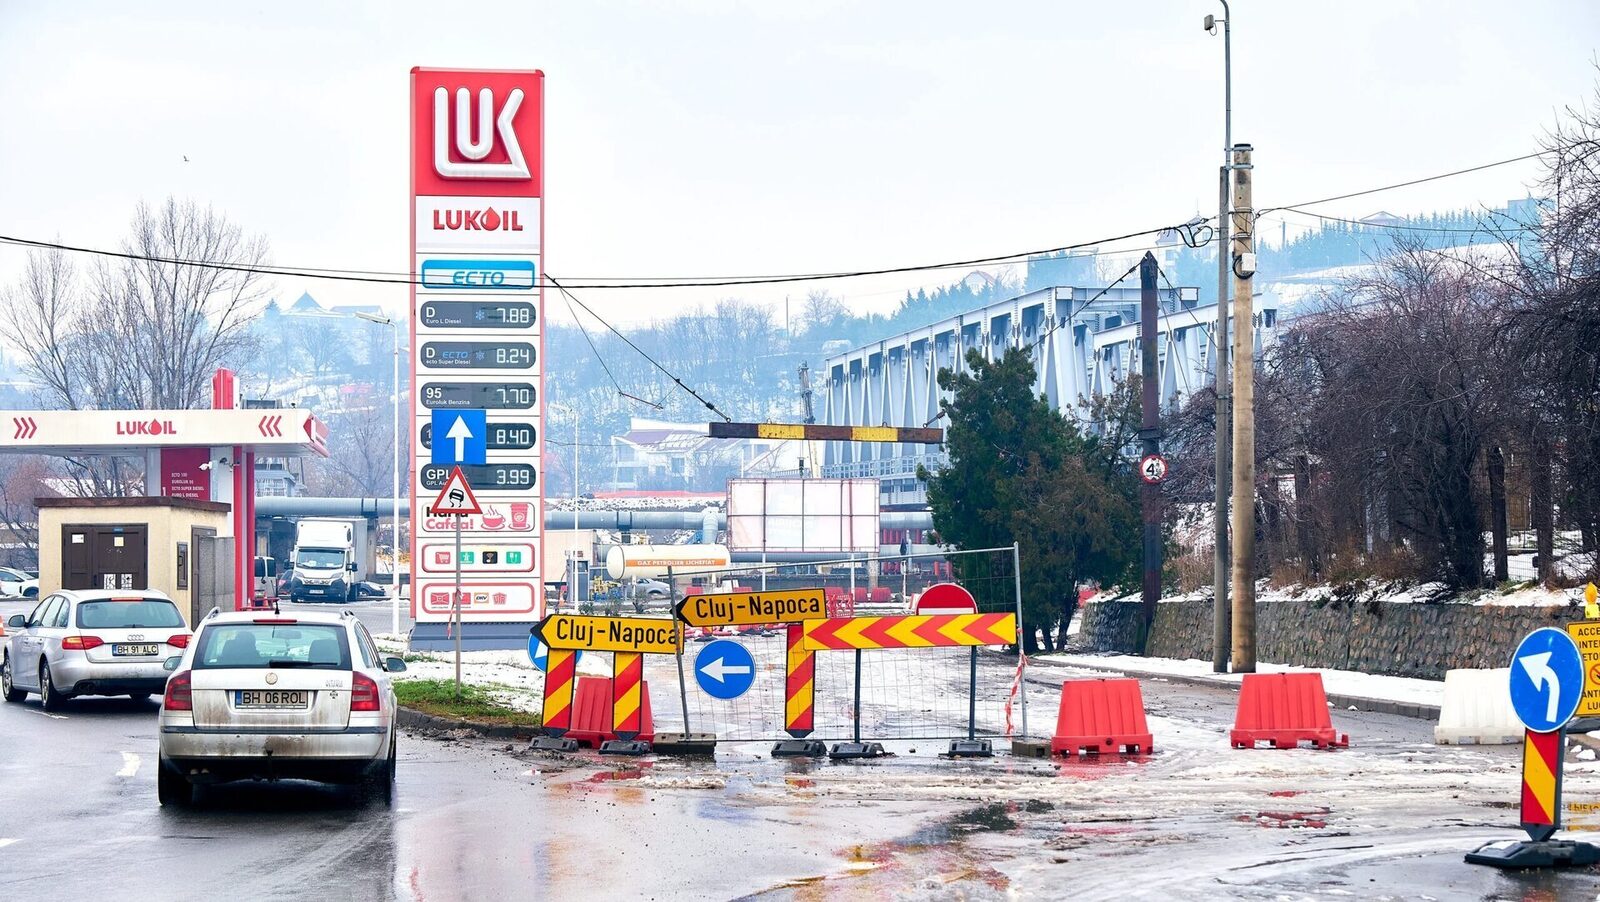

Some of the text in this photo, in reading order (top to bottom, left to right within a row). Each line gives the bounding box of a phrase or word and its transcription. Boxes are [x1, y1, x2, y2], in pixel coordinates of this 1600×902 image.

[433, 206, 524, 231] LUKOIL
[452, 271, 505, 285] ECTO
[426, 307, 530, 323] D 7.88
[426, 347, 530, 363] D ECTO 8.24
[426, 387, 530, 404] 95 7.70
[116, 418, 177, 436] LUKOIL
[496, 429, 530, 445] 8.40
[496, 469, 530, 485] 3.99
[652, 559, 685, 567] PETROLIER
[695, 595, 820, 622] Cluj-Napoca
[556, 618, 679, 649] Cluj-Napoca
[131, 646, 139, 654] 91
[243, 692, 306, 704] BH 06 ROL
